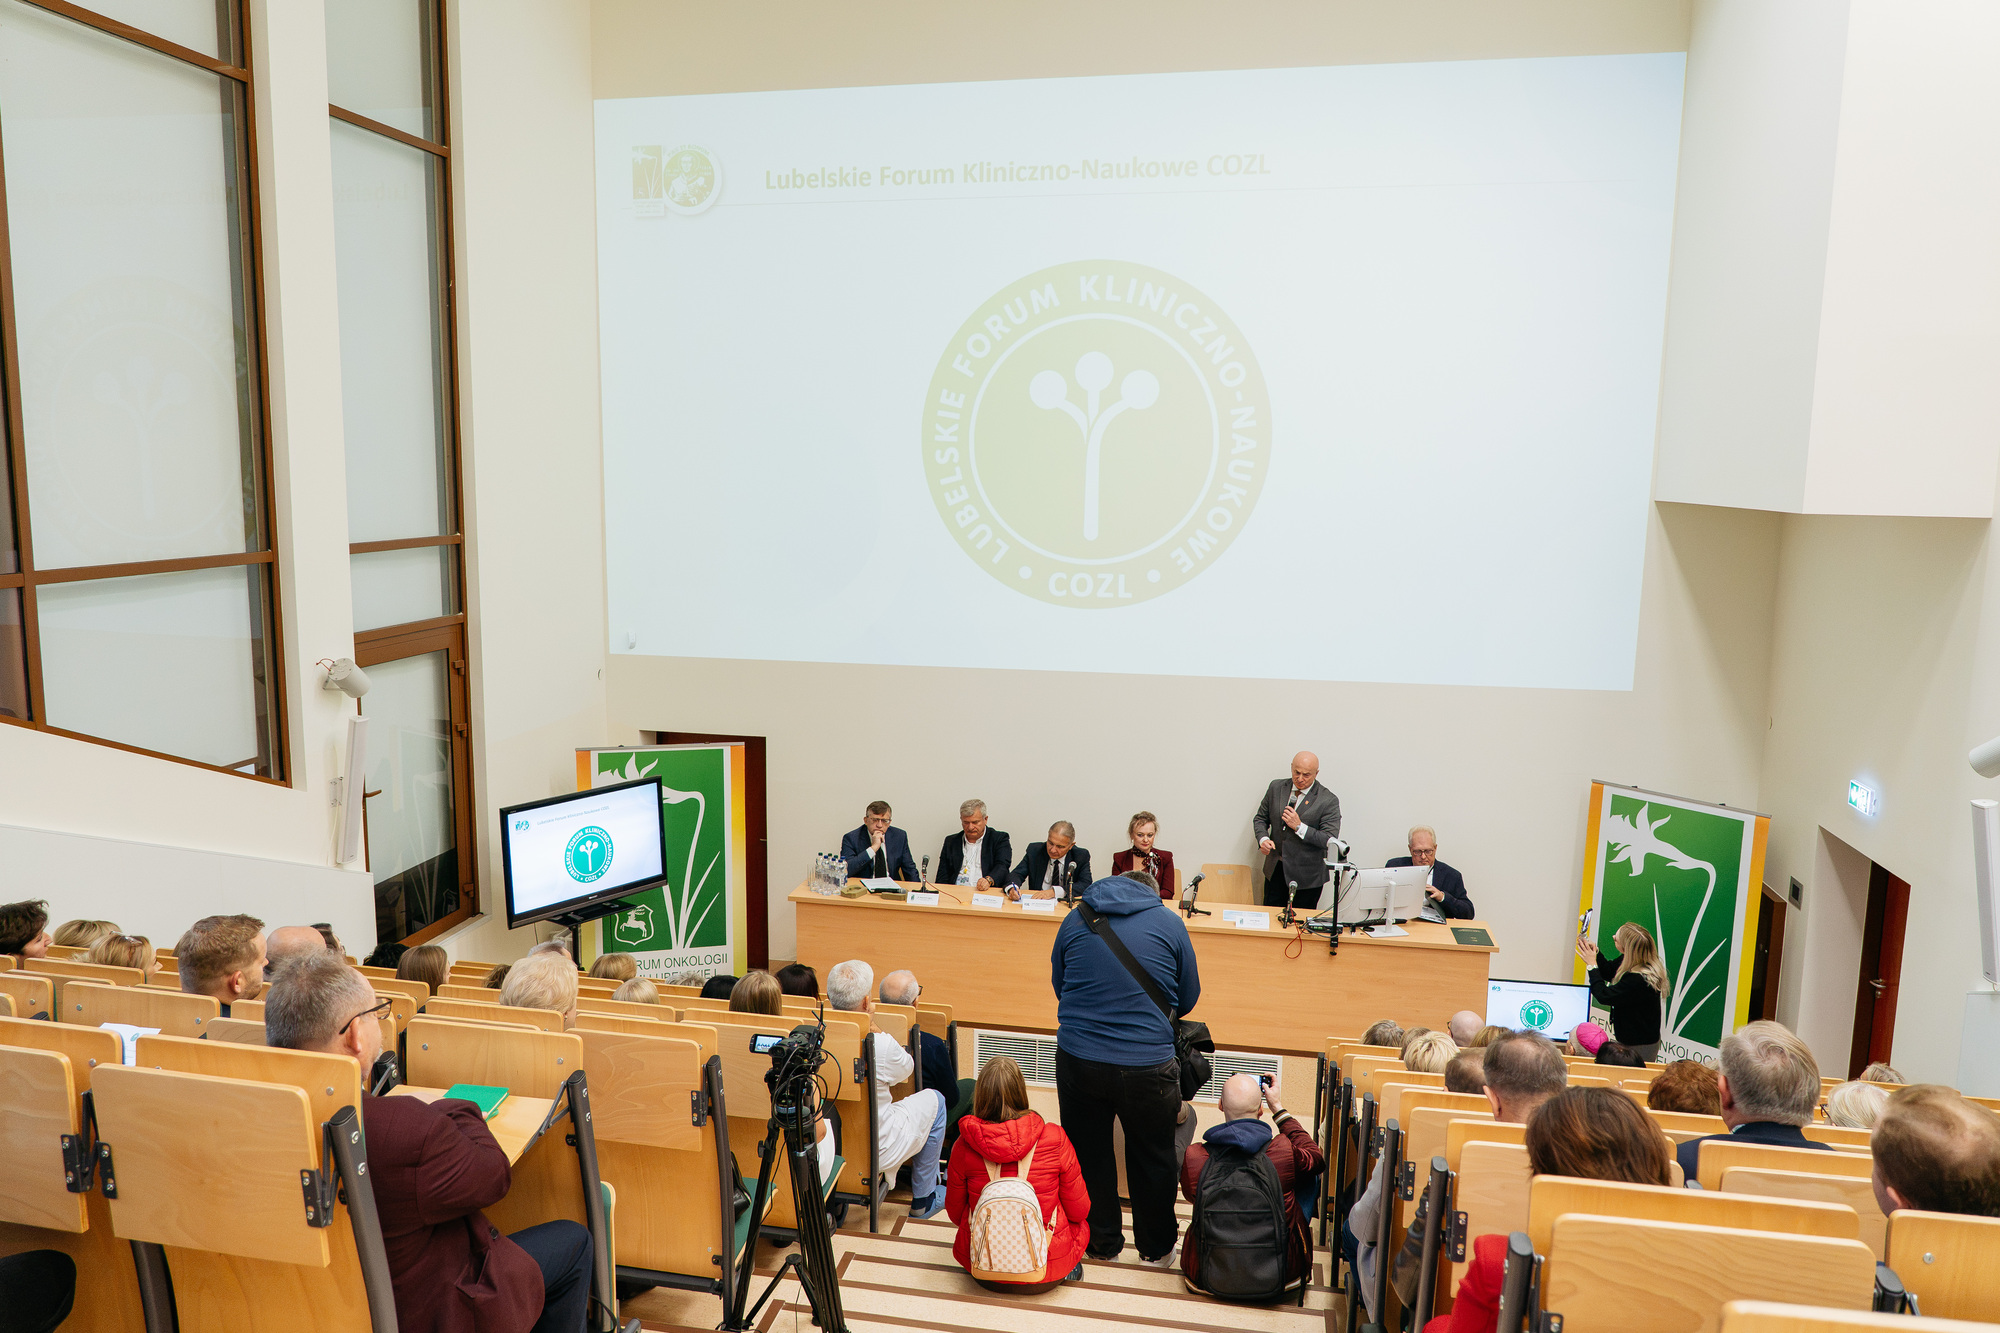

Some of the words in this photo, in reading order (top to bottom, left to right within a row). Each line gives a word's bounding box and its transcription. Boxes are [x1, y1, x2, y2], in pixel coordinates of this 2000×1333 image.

[765, 166, 872, 189] Lubelskie
[879, 166, 954, 186] Forum
[963, 156, 1198, 183] Kliniczno-Naukowe
[1206, 154, 1271, 176] COZL
[952, 282, 1060, 379] FORUM
[1079, 274, 1258, 574] KLINICZNO-NAUKOWE
[934, 388, 1011, 565] LUBELSKIE
[1048, 571, 1133, 599] COZL
[664, 953, 728, 969] ONKOLOGII
